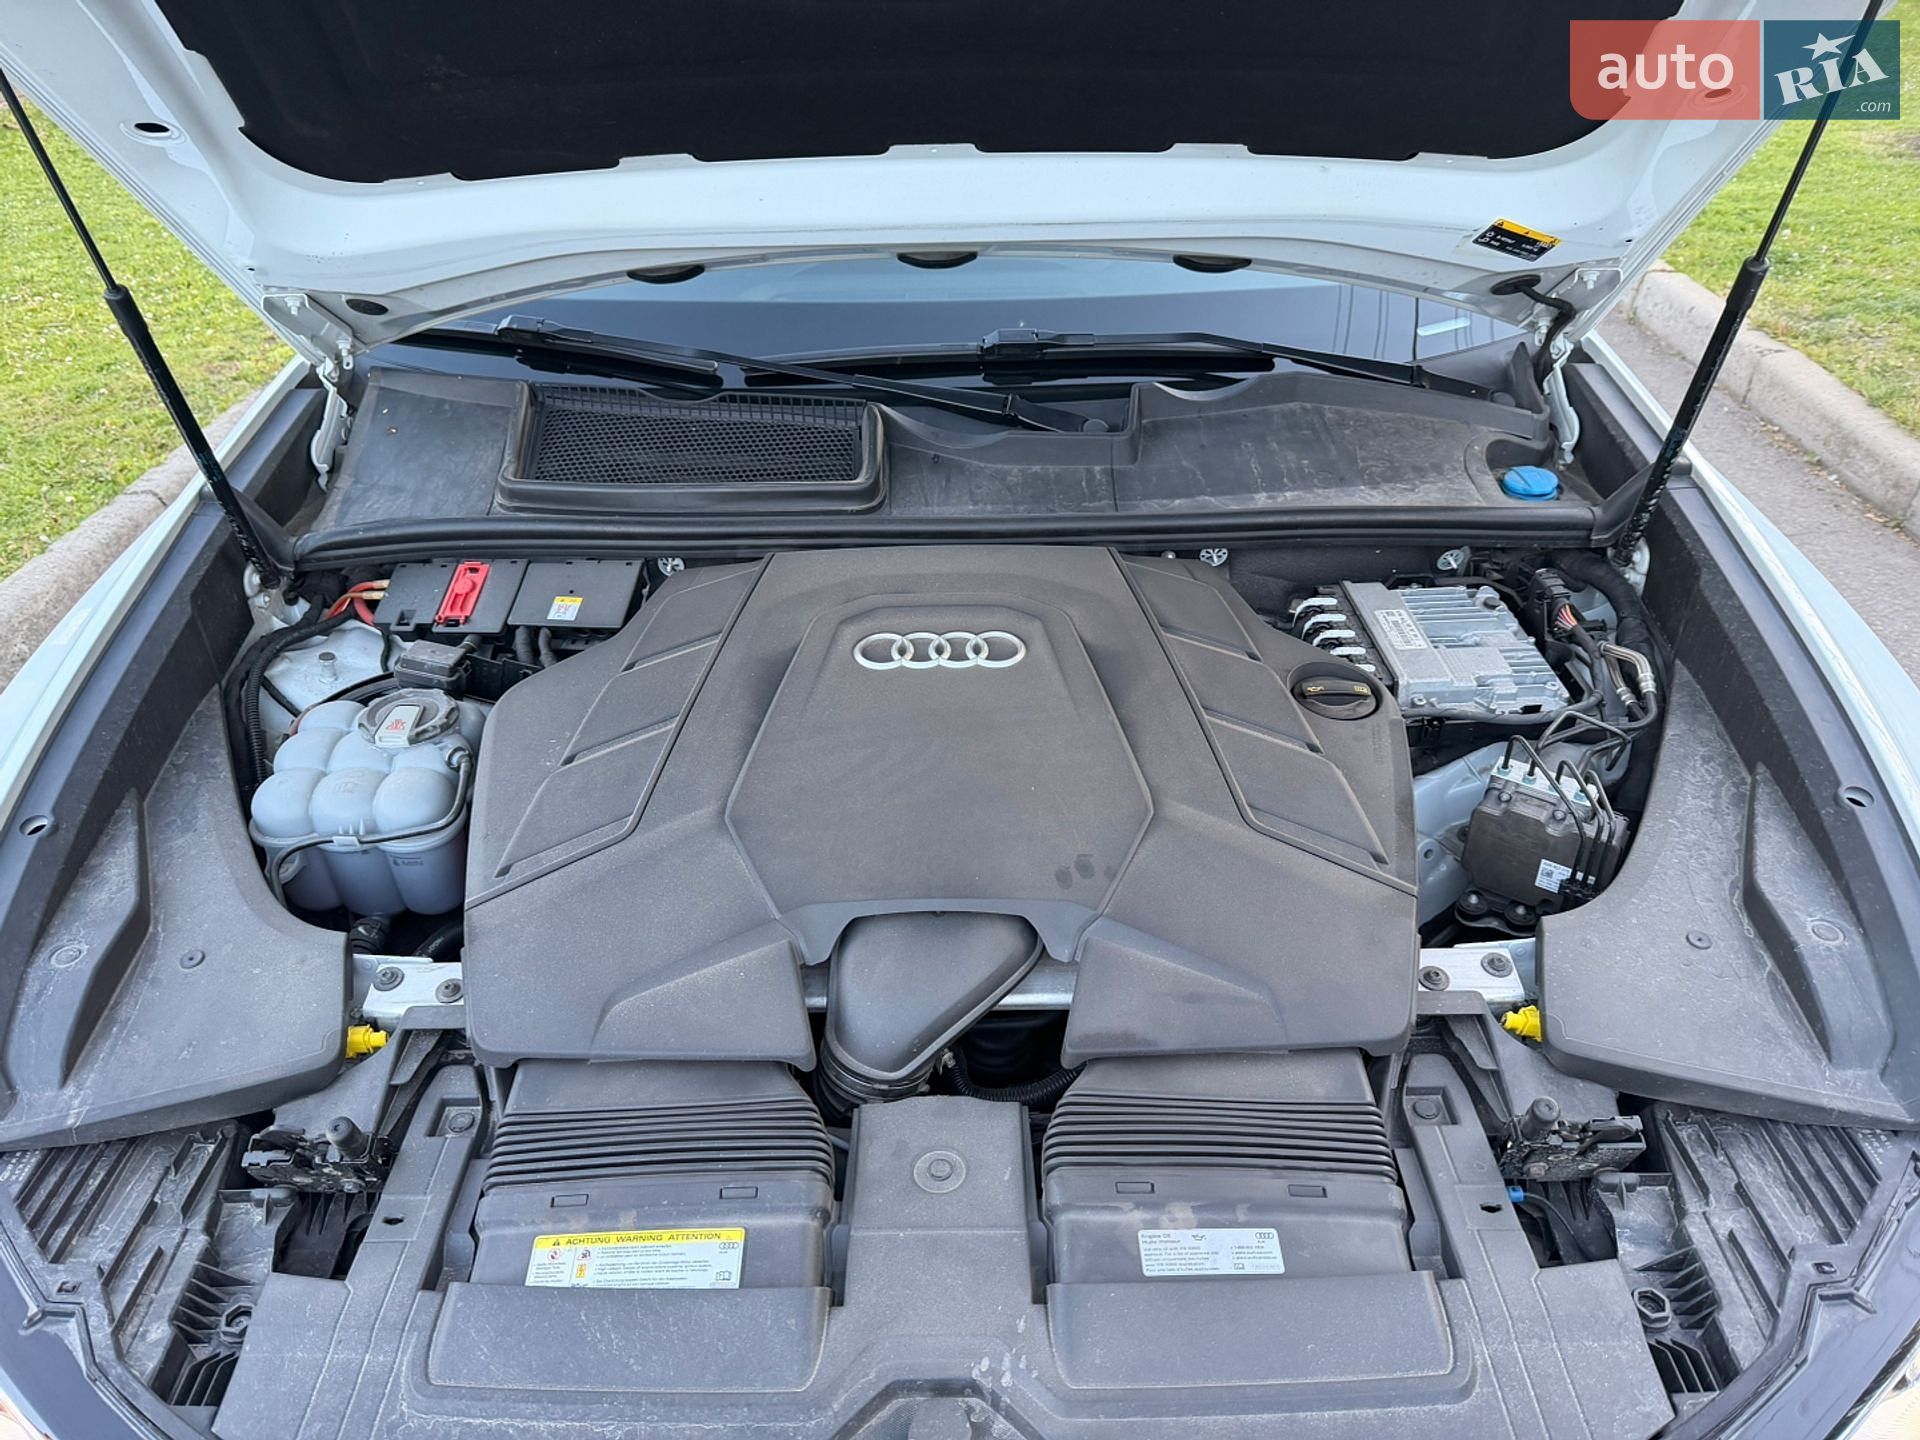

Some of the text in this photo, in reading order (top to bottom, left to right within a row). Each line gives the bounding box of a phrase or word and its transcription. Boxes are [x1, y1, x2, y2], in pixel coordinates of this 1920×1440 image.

[566, 1232, 721, 1245] ACHTUNG WARNING ATTENTION
